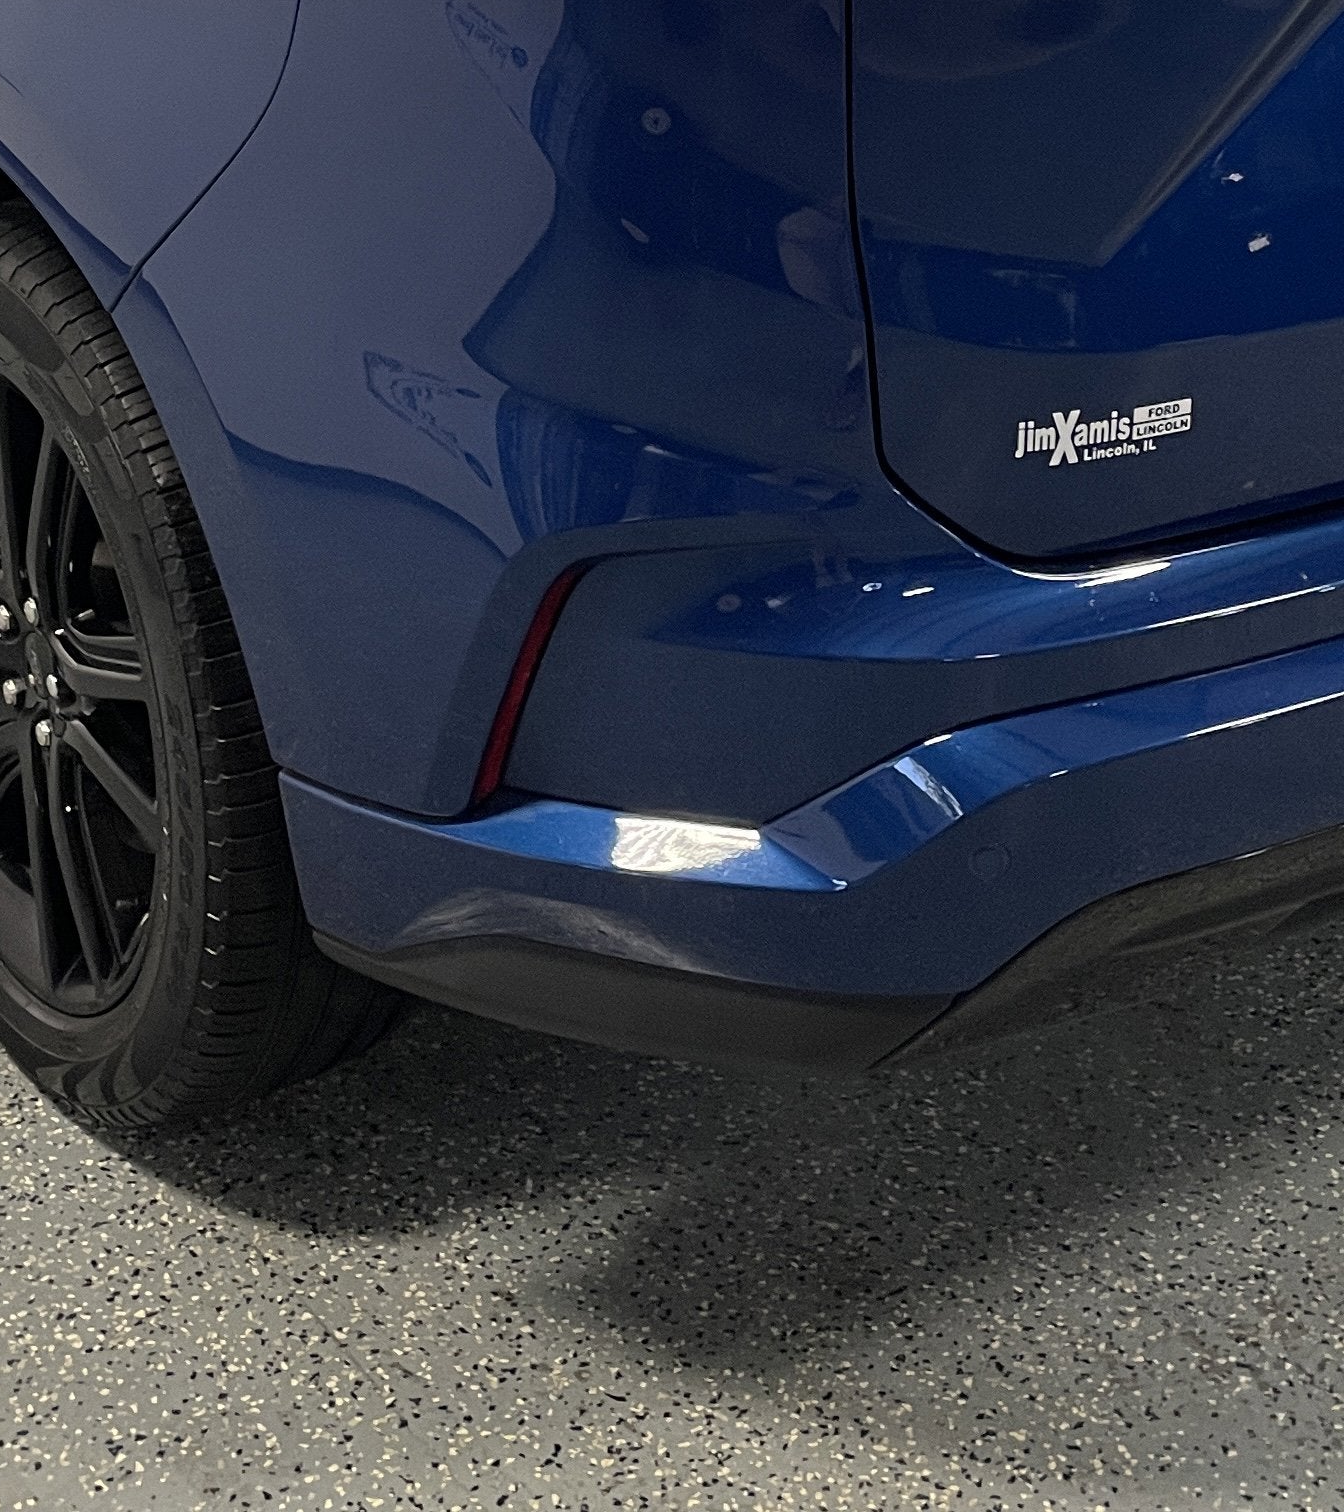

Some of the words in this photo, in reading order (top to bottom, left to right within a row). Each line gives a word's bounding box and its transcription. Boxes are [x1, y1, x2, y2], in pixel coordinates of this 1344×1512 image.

[1147, 403, 1180, 419] FORD
[1136, 418, 1189, 437] LINCOLN
[1083, 442, 1140, 462] Lincoln,
[1143, 439, 1157, 452] IL
